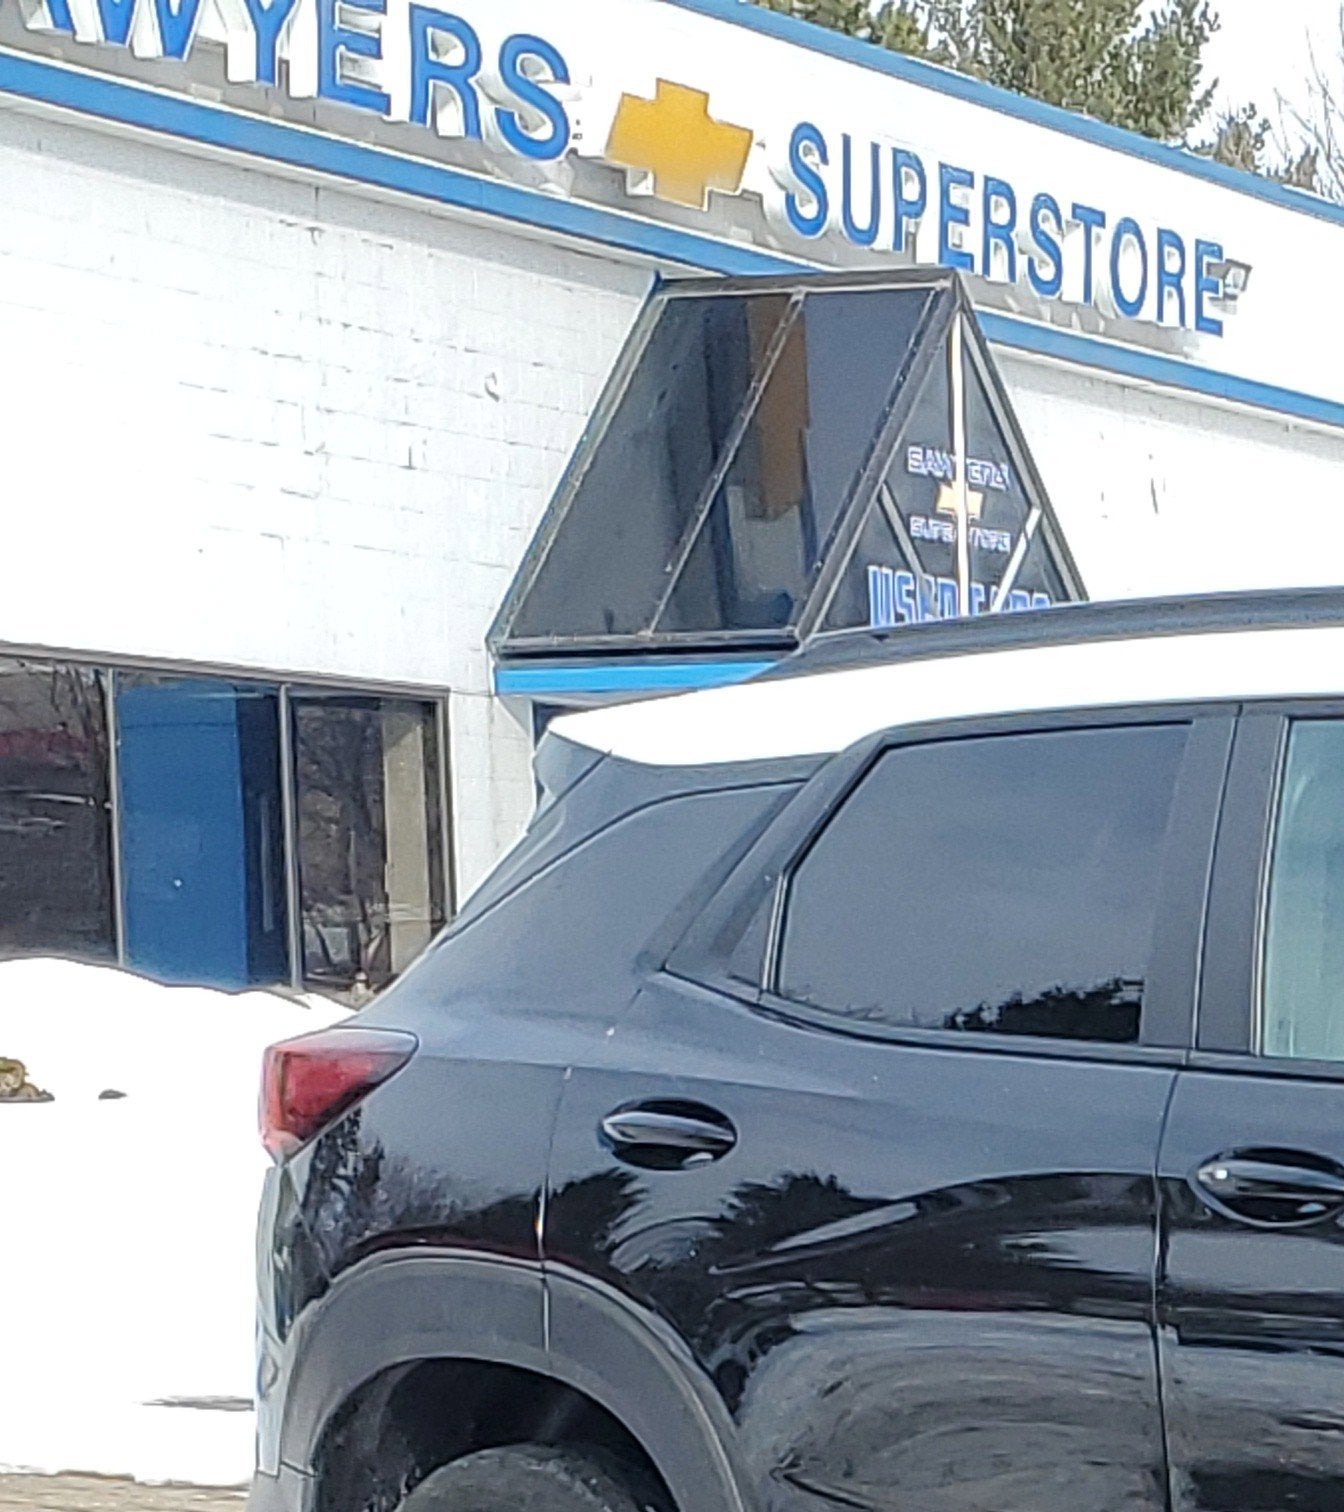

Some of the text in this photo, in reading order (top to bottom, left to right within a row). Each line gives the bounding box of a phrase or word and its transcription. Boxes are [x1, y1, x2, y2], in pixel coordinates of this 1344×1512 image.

[46, 0, 1223, 336] YERS SUPERSTORE
[908, 446, 1010, 491] SAWERS
